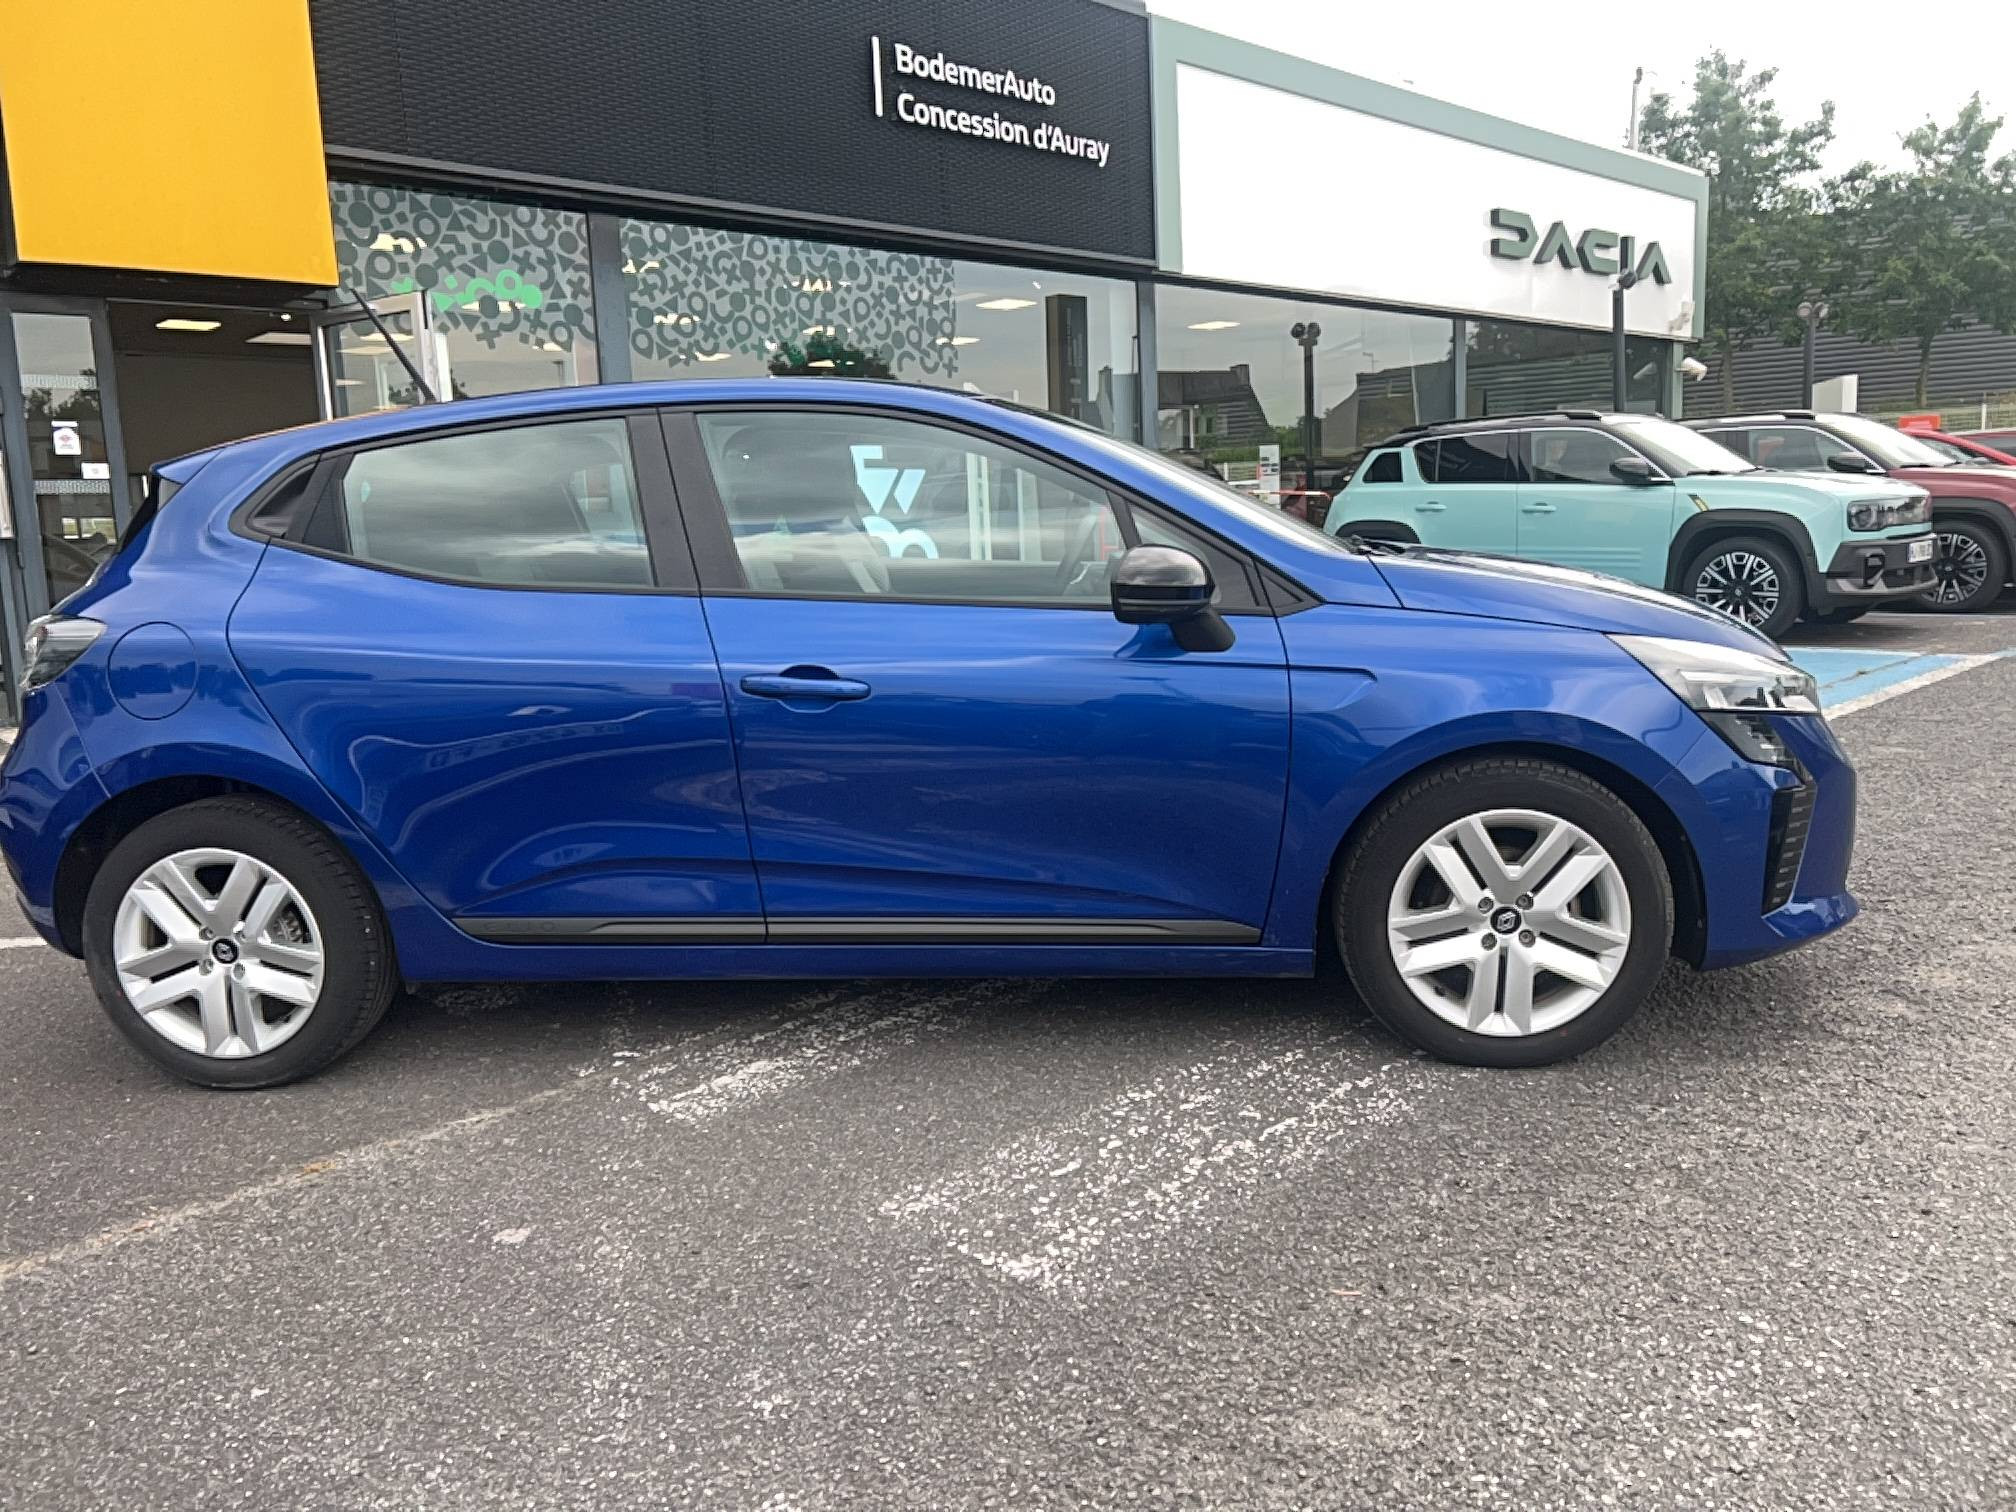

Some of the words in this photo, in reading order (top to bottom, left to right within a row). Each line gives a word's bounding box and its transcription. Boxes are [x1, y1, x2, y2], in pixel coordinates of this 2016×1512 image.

[894, 43, 1056, 106] BodemerAuto
[897, 92, 1030, 146] Concession
[1033, 122, 1110, 168] d'Auray
[1490, 207, 1672, 286] DACIA
